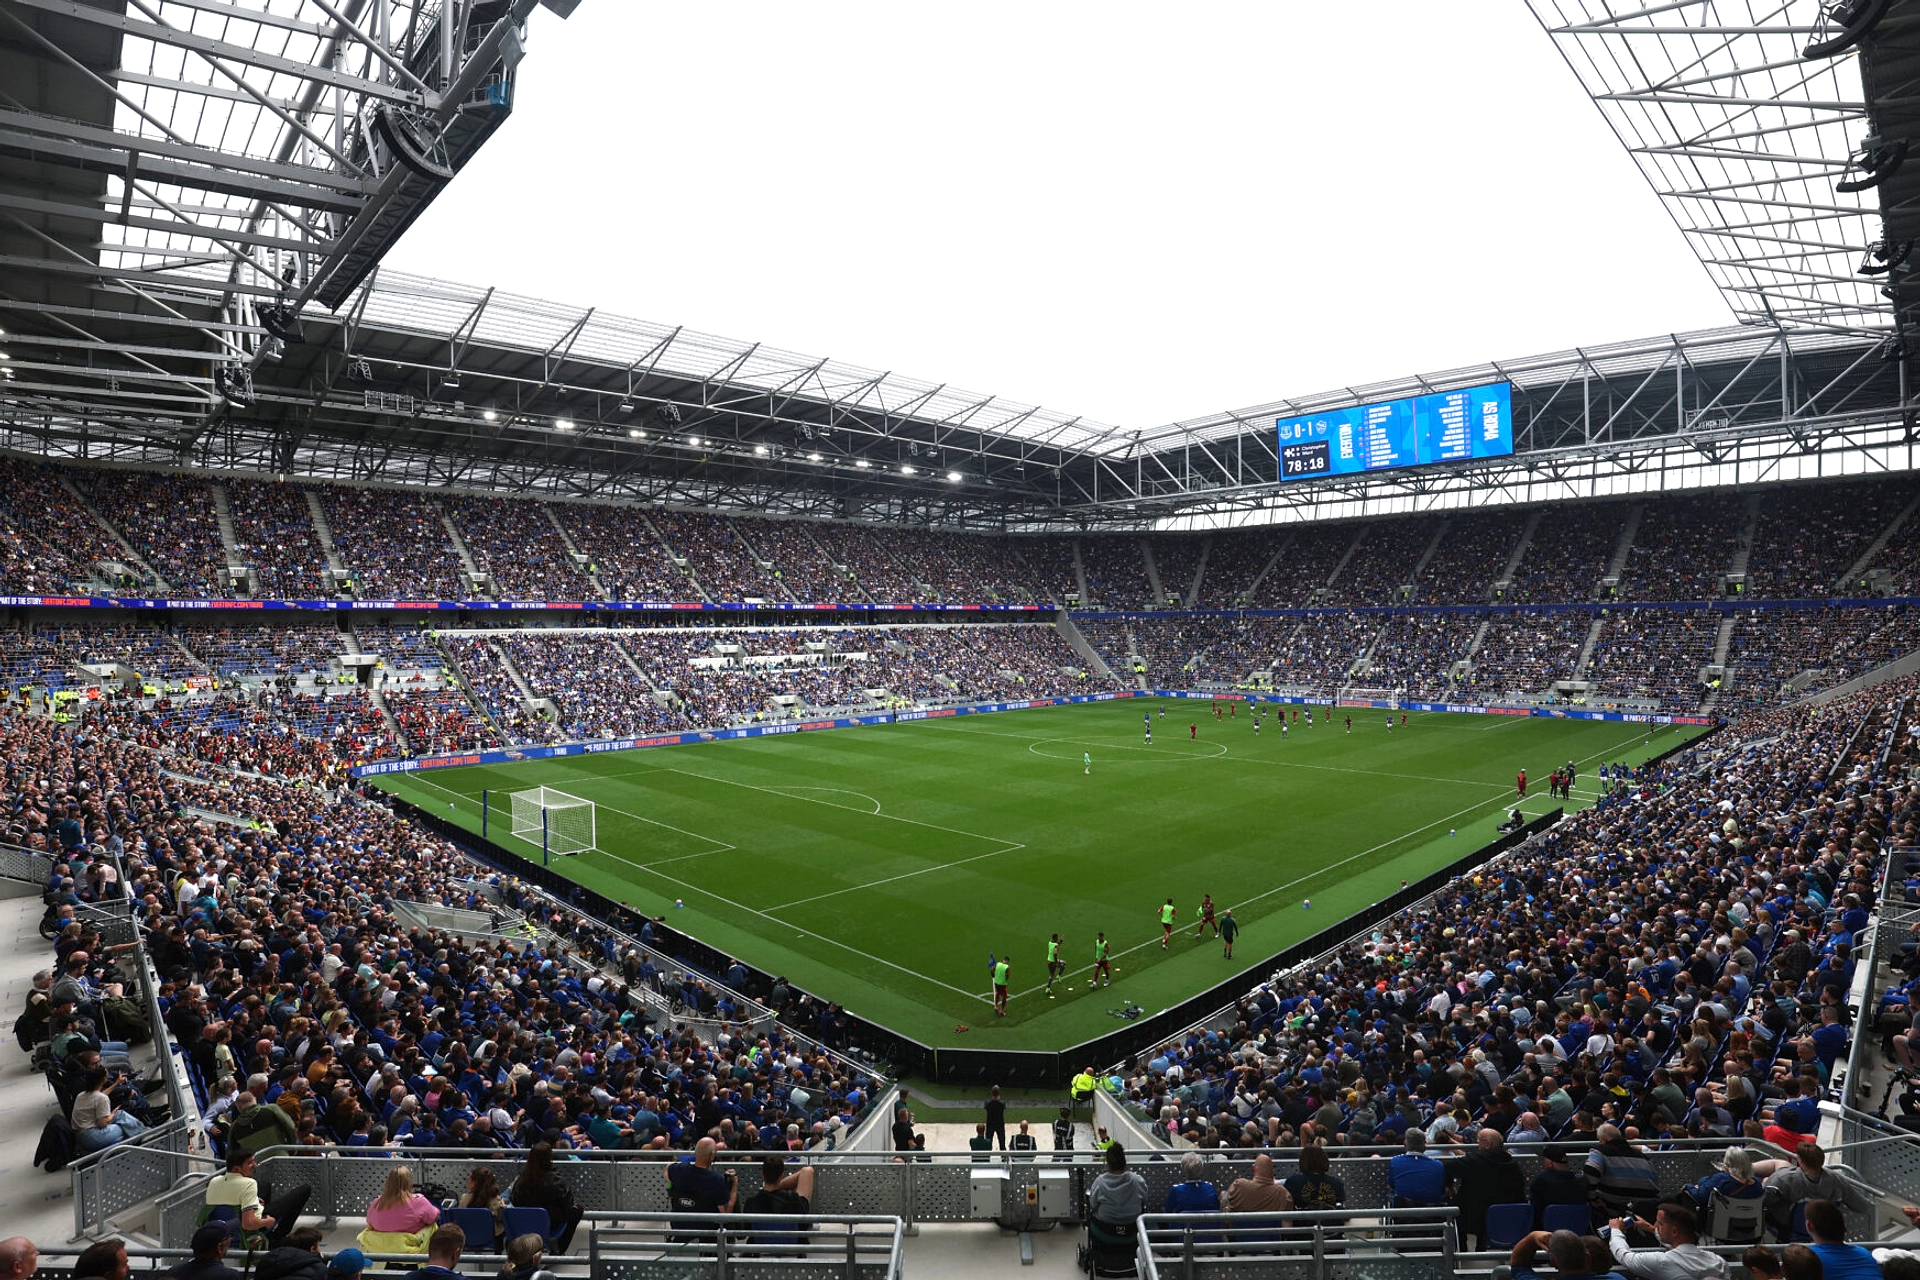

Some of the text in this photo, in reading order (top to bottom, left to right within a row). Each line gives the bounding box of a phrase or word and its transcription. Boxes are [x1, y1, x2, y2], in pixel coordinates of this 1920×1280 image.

[1482, 401, 1499, 441] AS ROMA
[1339, 423, 1354, 459] EVERTON
[1287, 457, 1324, 473] 78:18
[593, 742, 604, 751] PART
[605, 742, 611, 750] OF
[611, 741, 619, 750] THE
[367, 765, 379, 774] PART
[380, 763, 387, 773] OF
[388, 762, 399, 772] THE
[399, 760, 419, 771] STORY:
[419, 755, 481, 769] EVERTONFC.COM/TOURS
